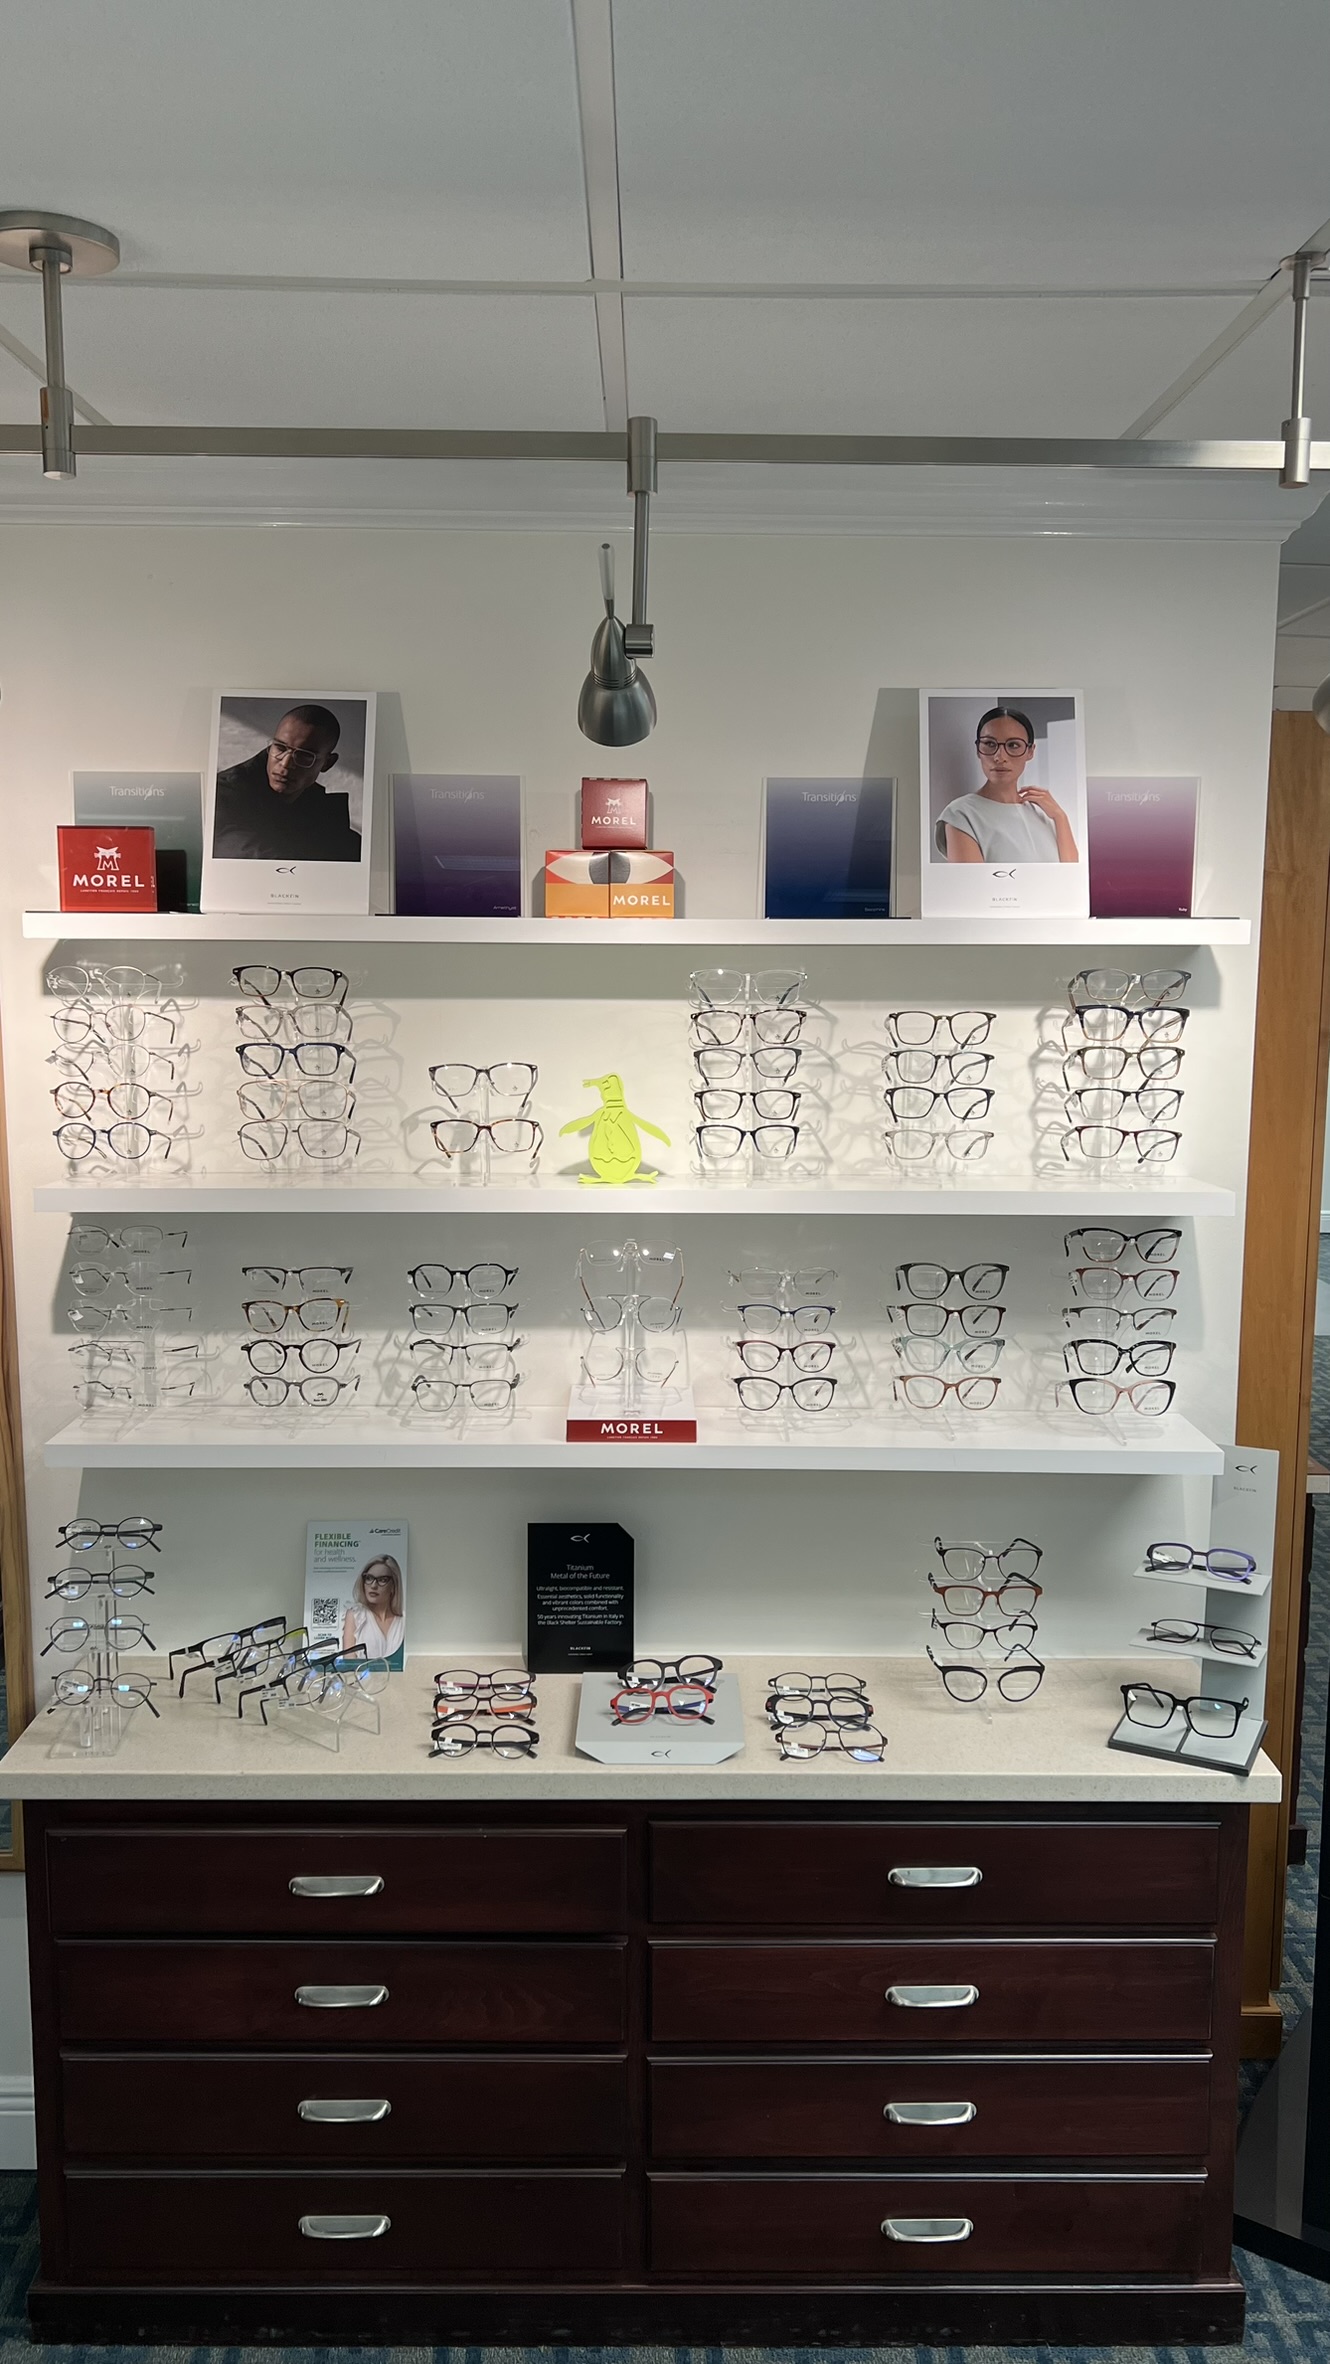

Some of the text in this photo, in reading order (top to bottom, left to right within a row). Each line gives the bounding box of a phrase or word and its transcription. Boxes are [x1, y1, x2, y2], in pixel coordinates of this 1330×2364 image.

[109, 784, 165, 800] Transitions
[430, 788, 485, 804] Transitions
[802, 790, 857, 806] Transitions
[1105, 790, 1161, 806] Transitions
[591, 816, 637, 825] MOREL
[72, 874, 145, 888] MOREL
[613, 895, 671, 906] MOREL
[600, 1423, 663, 1434] MOREL
